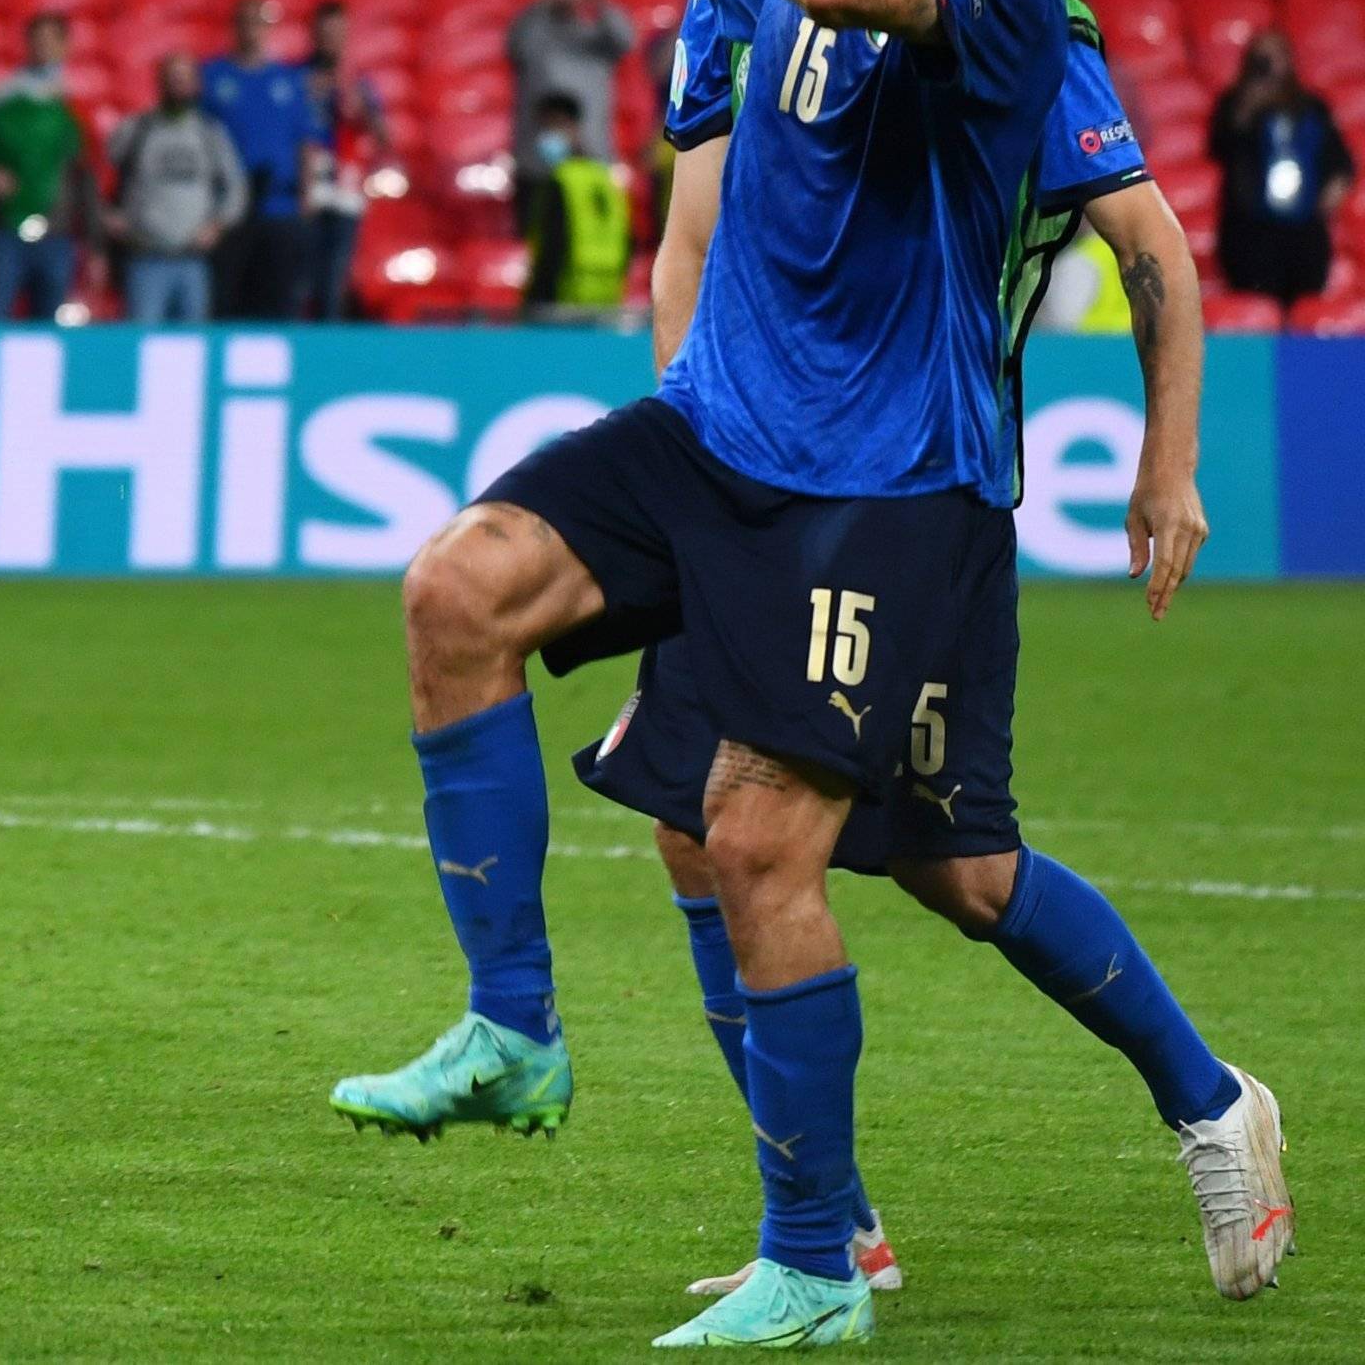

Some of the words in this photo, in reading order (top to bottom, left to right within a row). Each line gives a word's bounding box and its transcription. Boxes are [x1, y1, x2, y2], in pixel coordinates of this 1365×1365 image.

[778, 16, 837, 124] 15
[806, 588, 876, 687] 15
[894, 682, 949, 776] 5
